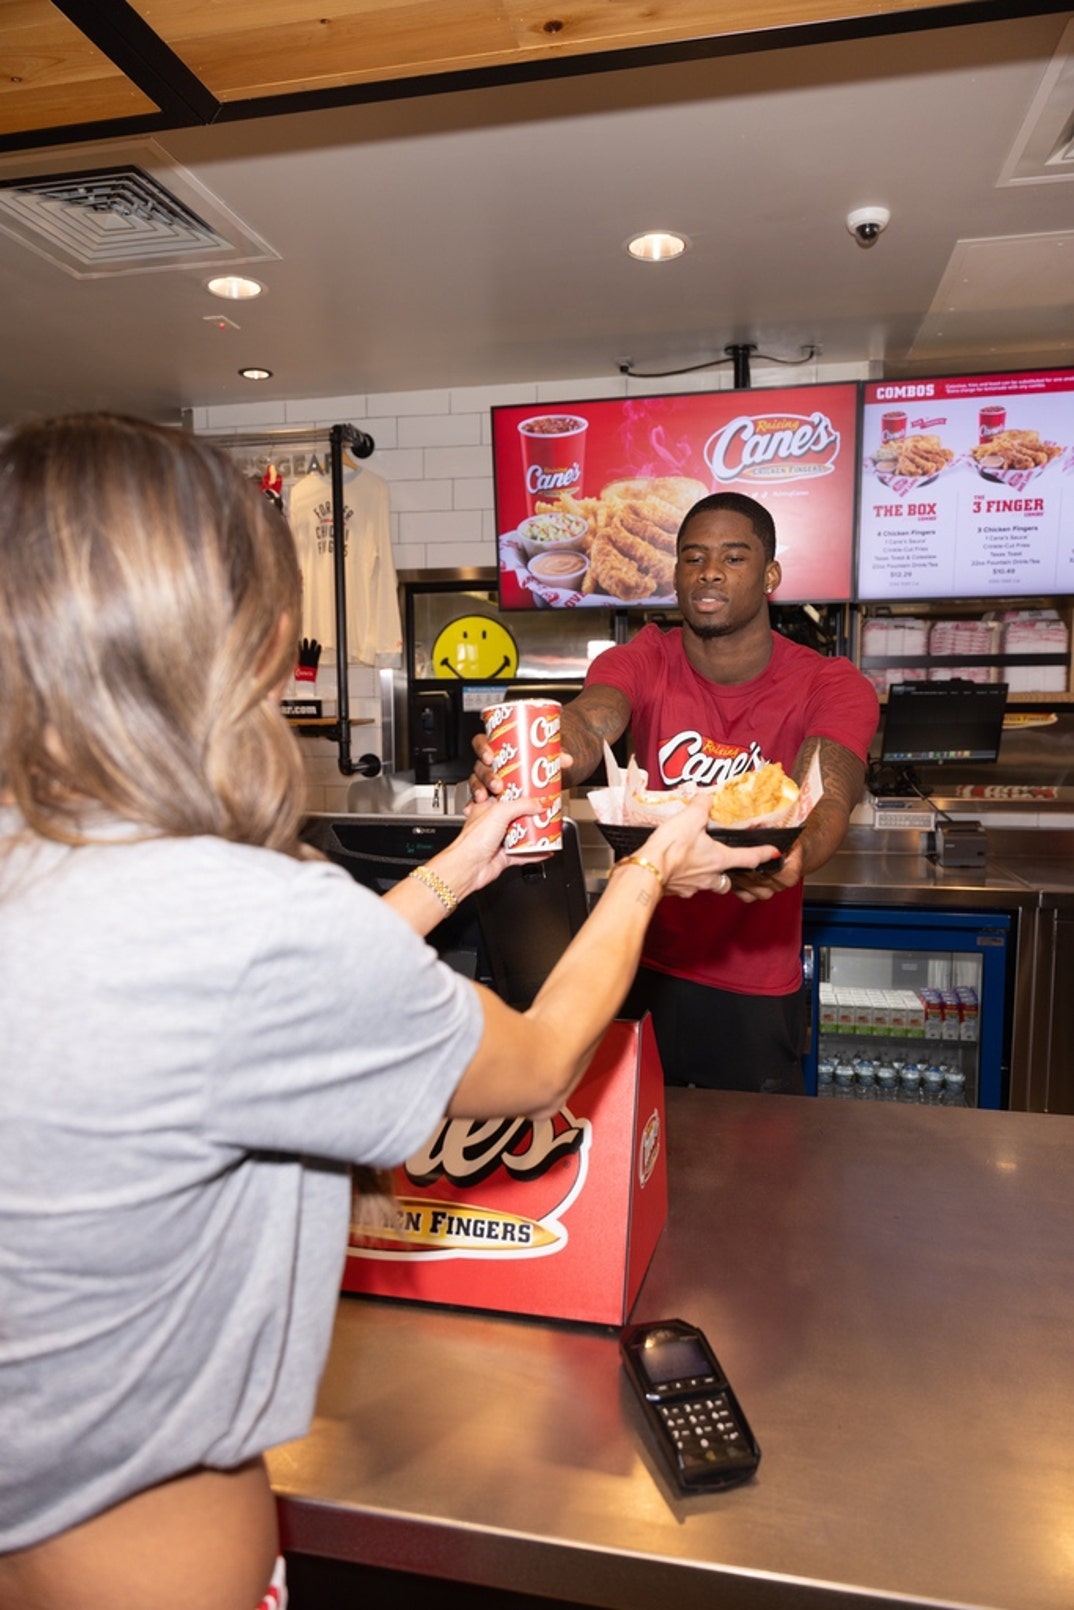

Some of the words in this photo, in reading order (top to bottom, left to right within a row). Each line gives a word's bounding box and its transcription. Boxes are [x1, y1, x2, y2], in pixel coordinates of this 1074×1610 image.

[876, 384, 935, 400] COMBOS
[755, 418, 801, 433] Raising
[711, 412, 838, 480] Cane's
[526, 462, 581, 495] Cane's
[873, 504, 903, 517] THE
[907, 502, 937, 516] BOX
[972, 501, 983, 514] 3
[986, 498, 1044, 513] FINGER
[911, 529, 936, 537] Fingers
[1012, 525, 1039, 533] Fingers
[703, 738, 740, 758] Raising
[658, 730, 771, 787] Cane's
[429, 1210, 532, 1243] FINGERS
